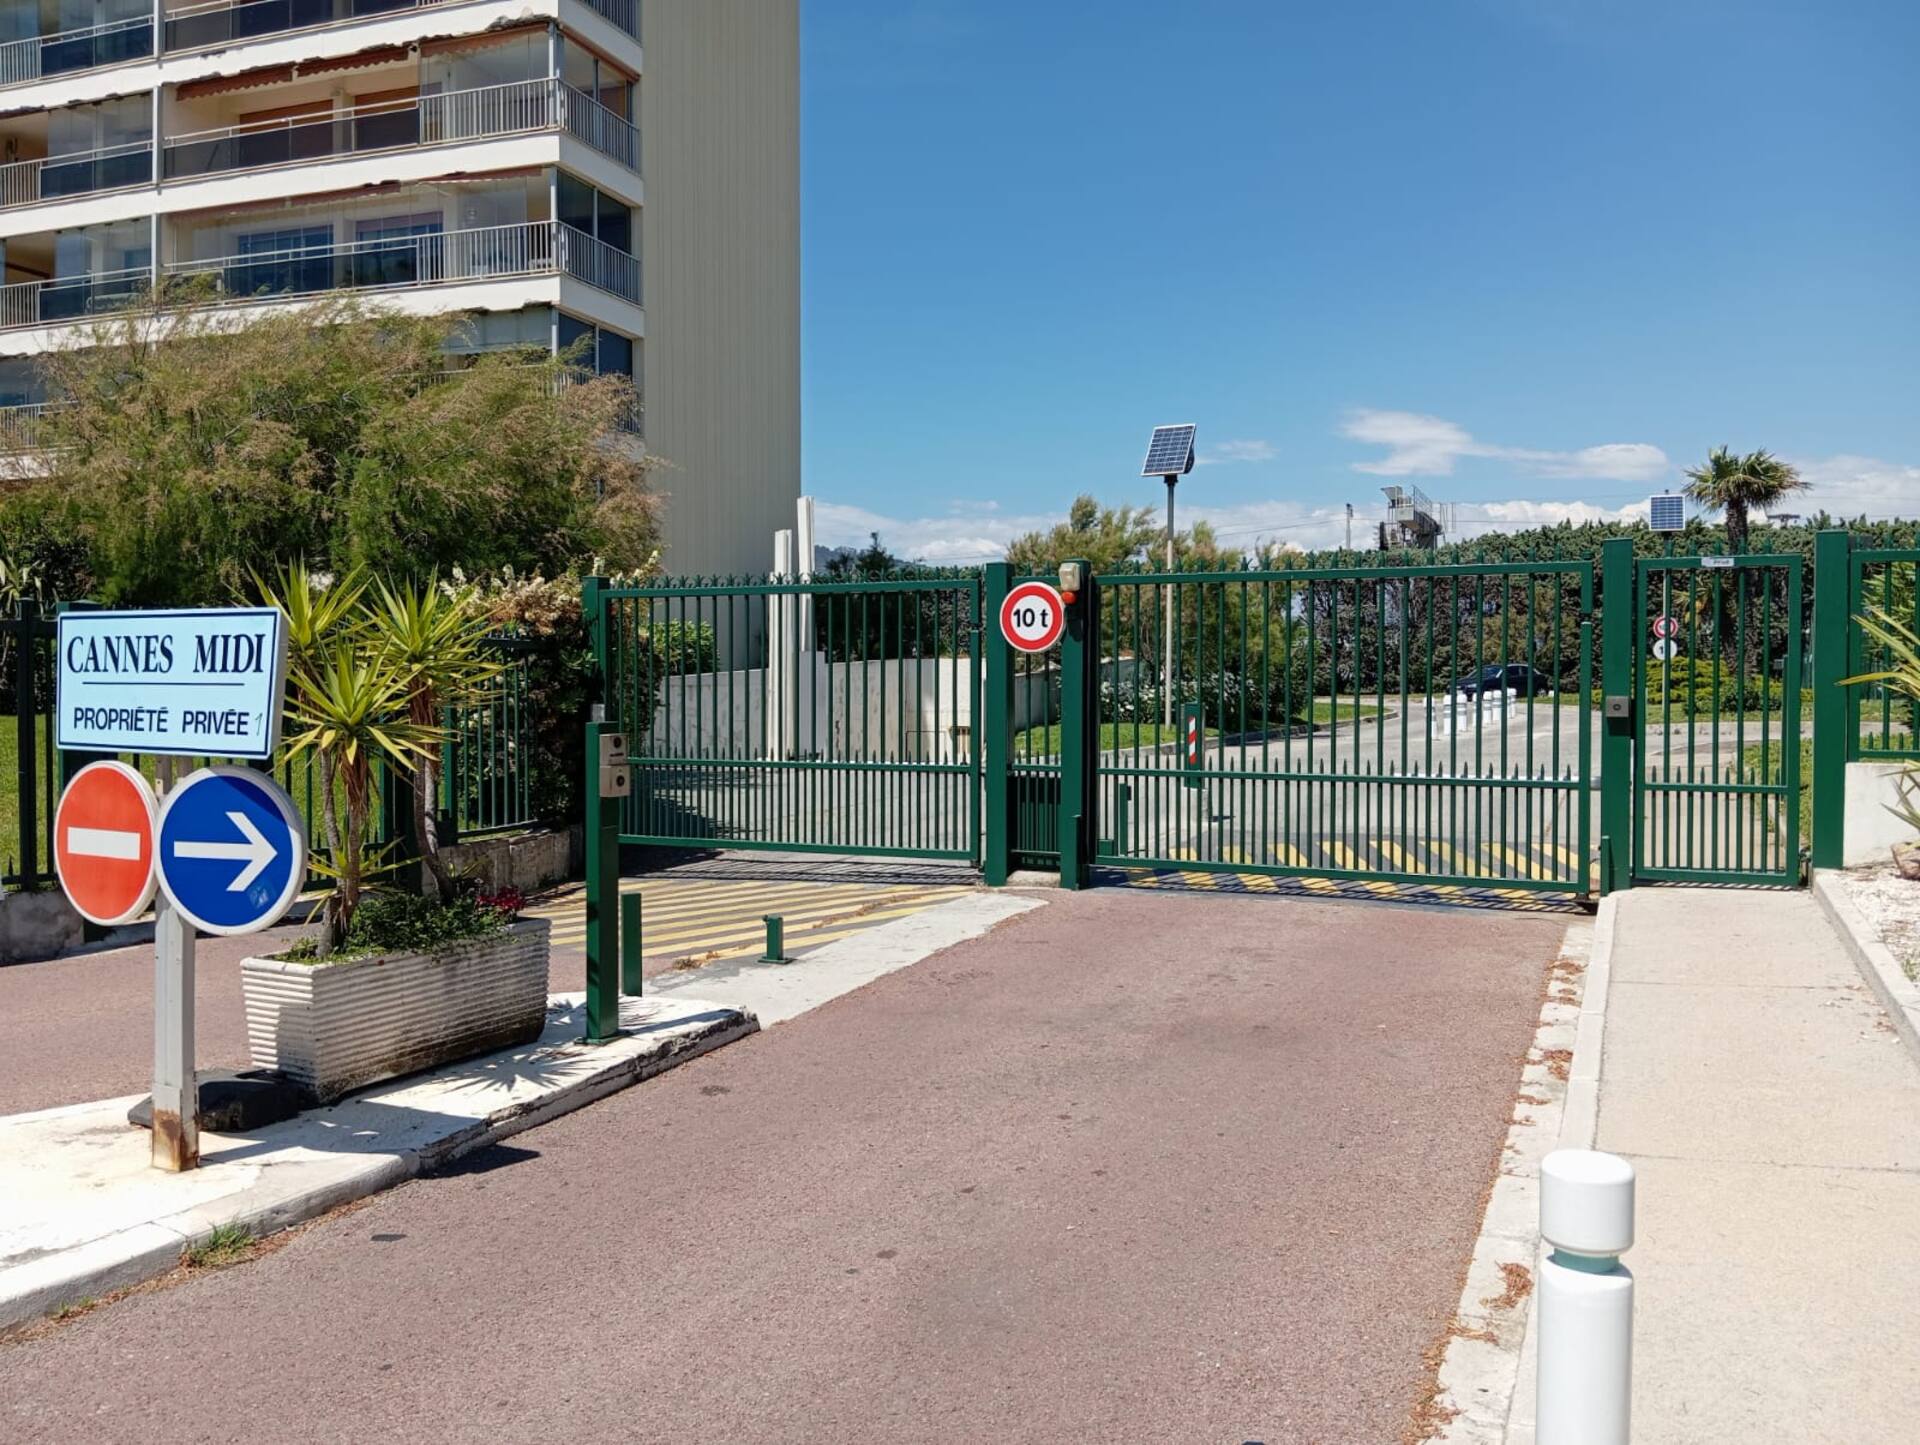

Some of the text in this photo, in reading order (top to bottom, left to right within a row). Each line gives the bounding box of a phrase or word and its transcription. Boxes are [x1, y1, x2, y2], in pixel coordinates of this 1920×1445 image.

[1013, 608, 1048, 628] 10 t
[67, 633, 266, 674] CANNES MIDI
[73, 706, 250, 736] PROPRIÉTÉ PRIVÉE
